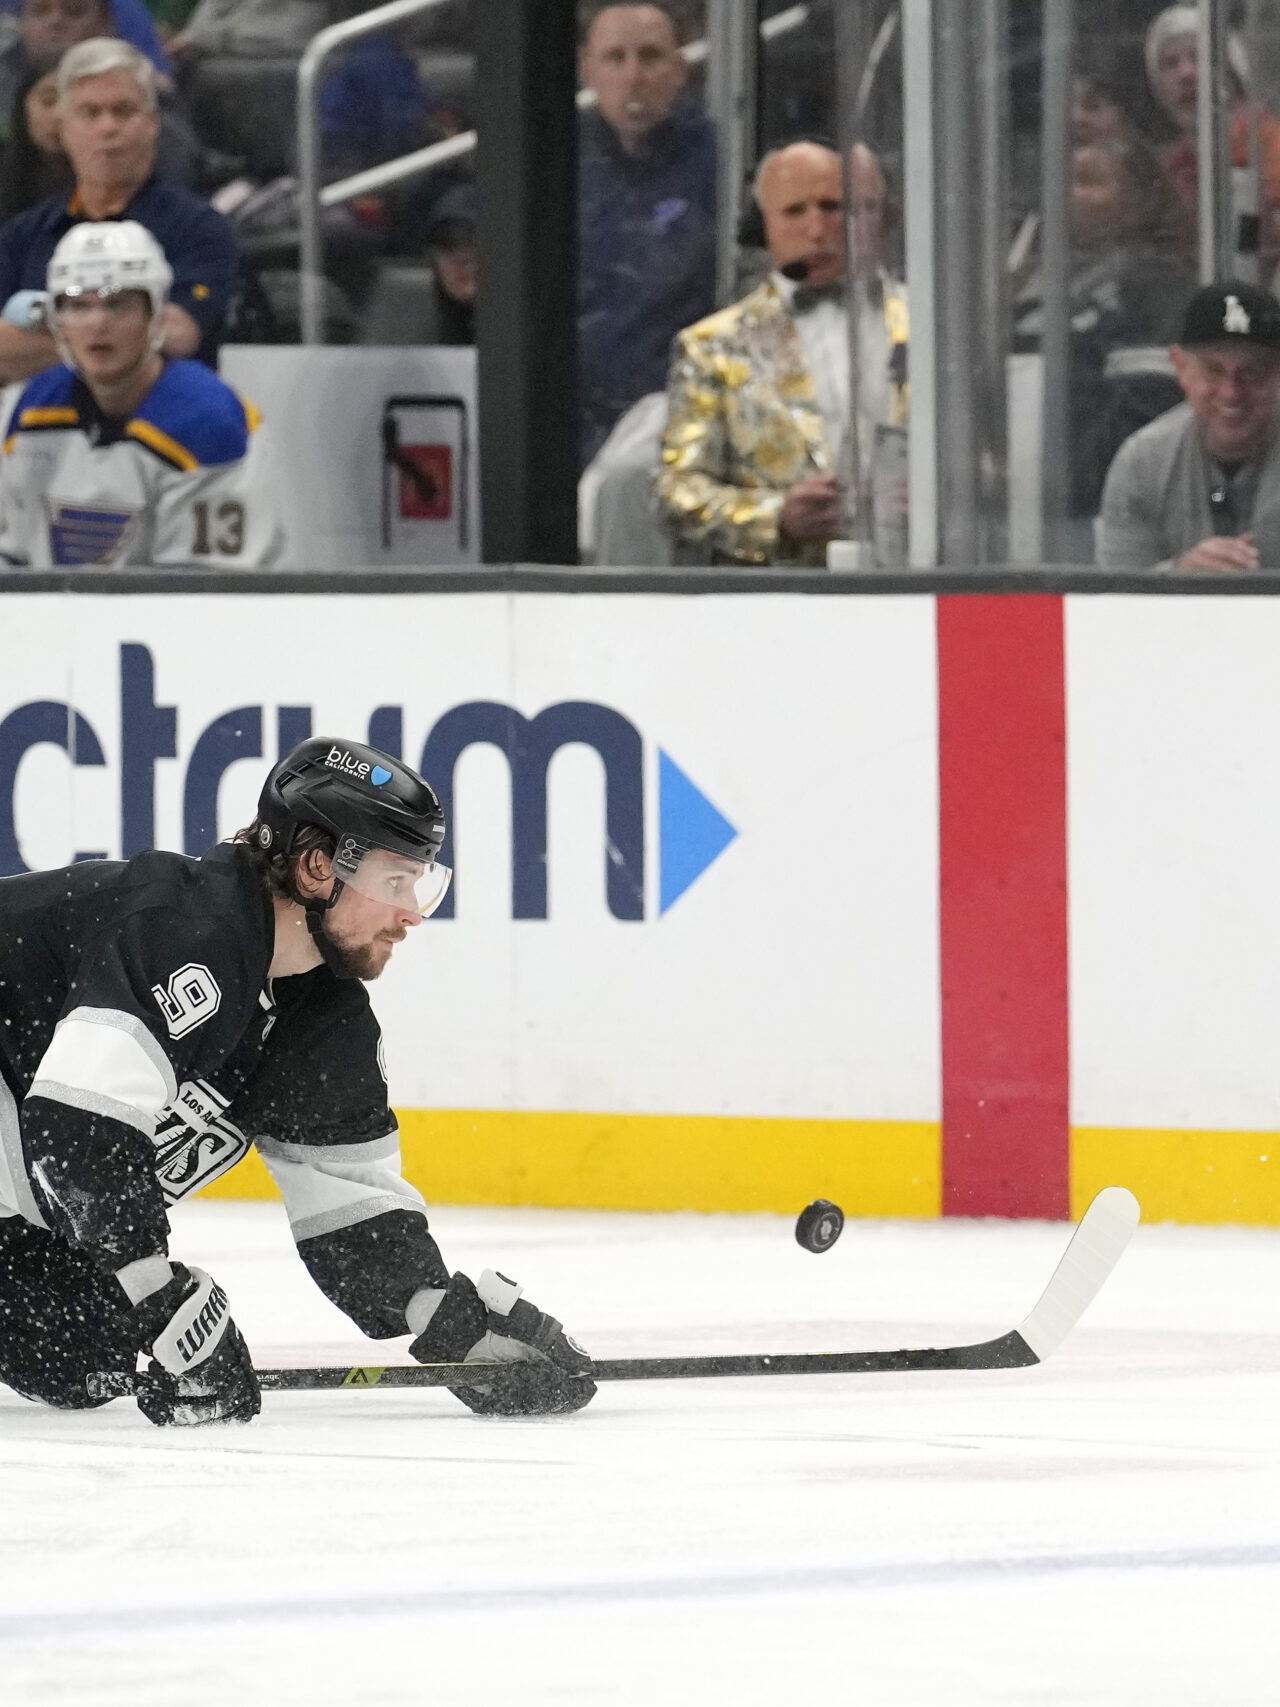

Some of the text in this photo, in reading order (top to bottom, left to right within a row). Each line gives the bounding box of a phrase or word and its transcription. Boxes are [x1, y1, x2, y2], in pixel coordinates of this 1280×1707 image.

[191, 499, 246, 556] 13
[324, 760, 366, 780] CALIFORNIA
[326, 745, 371, 775] blue
[150, 961, 222, 1041] 9
